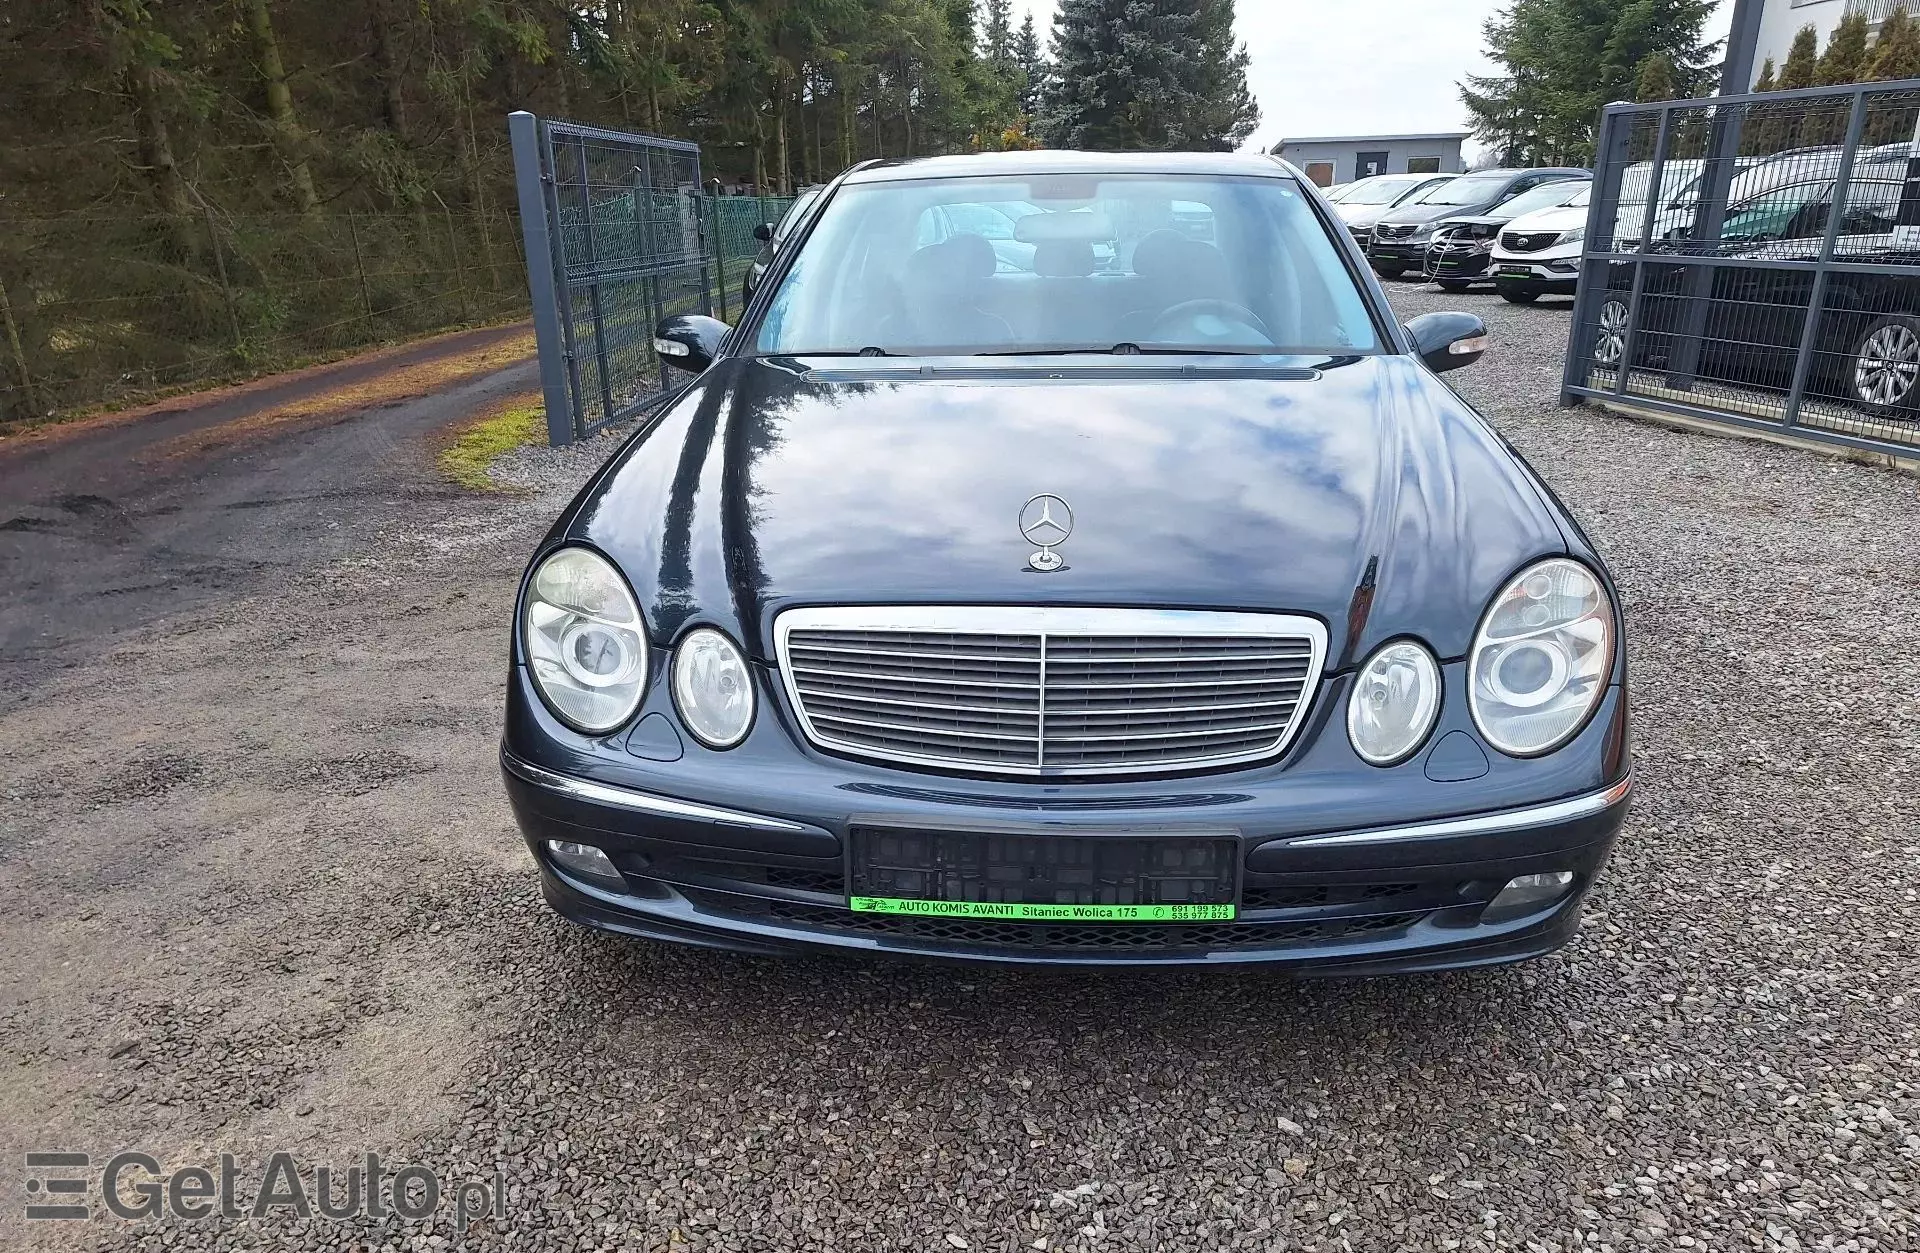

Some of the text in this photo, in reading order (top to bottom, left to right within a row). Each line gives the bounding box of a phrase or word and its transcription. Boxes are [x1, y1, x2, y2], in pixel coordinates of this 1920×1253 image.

[899, 901, 930, 912] AUTO
[932, 902, 970, 914] KOMIS
[972, 903, 1014, 915] AVANTI
[1022, 906, 1069, 917] Sitaniec
[1073, 907, 1113, 918] Wolica
[1117, 907, 1138, 918] 175
[1171, 905, 1228, 913] 691 199 573
[1171, 912, 1228, 920] 535 977 875
